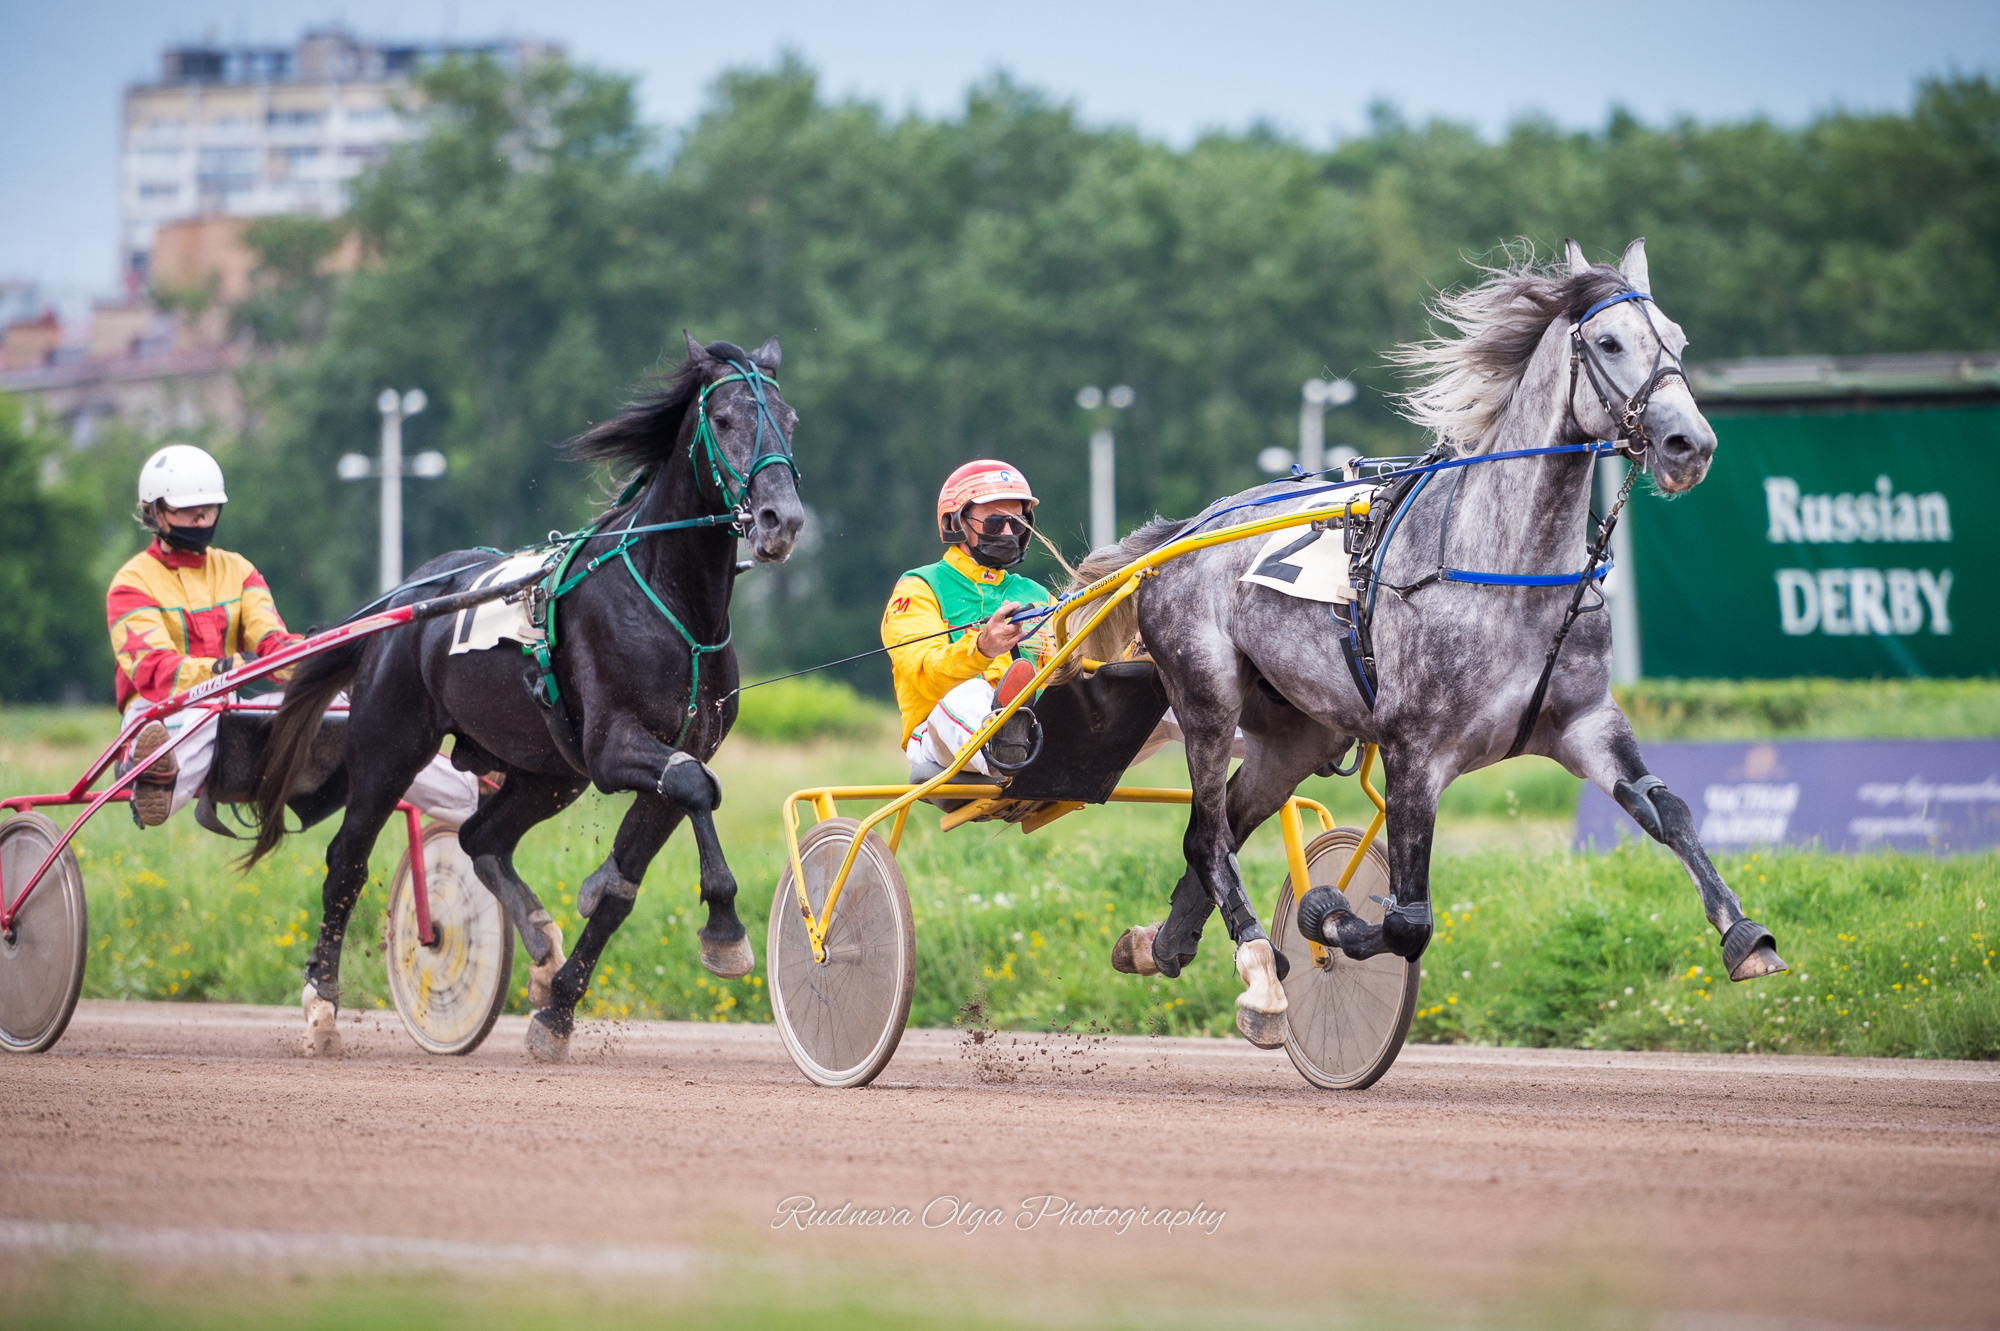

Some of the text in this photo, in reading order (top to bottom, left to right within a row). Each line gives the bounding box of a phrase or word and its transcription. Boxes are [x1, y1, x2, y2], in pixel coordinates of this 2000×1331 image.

[1252, 501, 1344, 584] 2
[1763, 474, 1953, 543] Russian
[1774, 567, 1953, 636] DERBY
[189, 673, 229, 699] ROYAL
